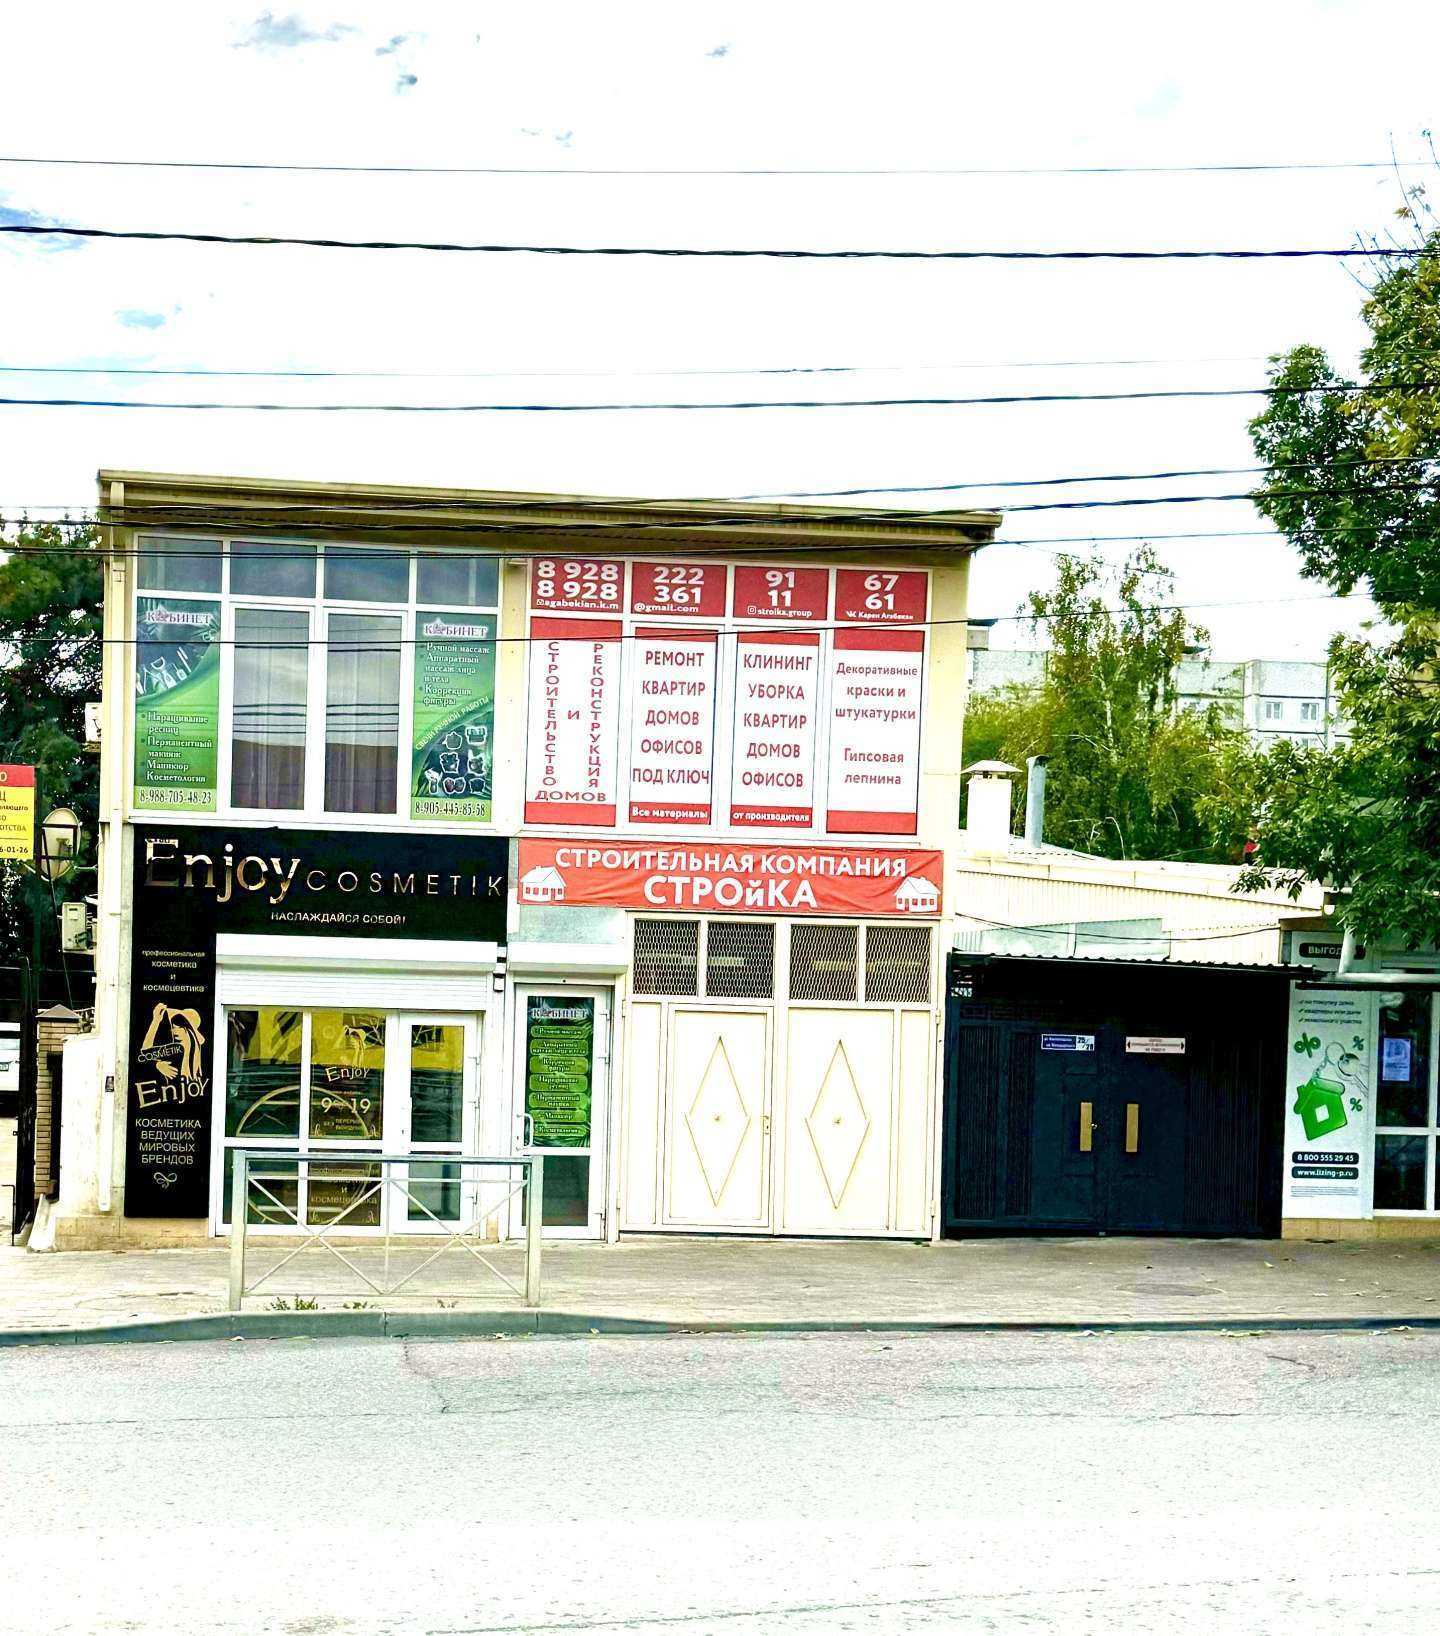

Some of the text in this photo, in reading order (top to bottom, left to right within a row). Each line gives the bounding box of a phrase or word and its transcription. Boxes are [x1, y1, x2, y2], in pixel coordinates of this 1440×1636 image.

[537, 560, 899, 591] 8 928 222 91 67
[537, 580, 895, 610] 8 928 361 11 61
[634, 602, 699, 613] @gmail.com
[645, 650, 704, 667] РЕМОНТ
[743, 654, 812, 671] КЛИНИНГ
[836, 662, 918, 677] Декоративные
[642, 681, 706, 696] КВАРТИР
[748, 684, 805, 700] УБОРКА
[847, 686, 906, 699] краски и
[543, 641, 560, 786] СТРОИТЕЛЬСТВО
[567, 710, 580, 720] И
[588, 643, 604, 788] РЕКОНСТРУКЦИЯ
[645, 710, 699, 727] ДОМОВ
[743, 713, 807, 729] КВАРТИР
[835, 708, 916, 722] штукатурки
[641, 739, 703, 755] ОФИСОВ
[746, 743, 801, 759] ДОМОВ
[844, 748, 904, 763] Гипсовая
[632, 768, 710, 785] ПОД КЛЮЧ
[742, 771, 804, 788] ОФИСОВ
[844, 773, 902, 785] лепнина
[534, 790, 607, 802] ДОМОВ
[632, 806, 708, 819] Все материалы
[732, 812, 745, 820] от
[554, 848, 907, 878] СТРОИТЕЛЬНАЯ КОМПАНИЯ
[144, 838, 503, 904] Enjoy COSMETIK
[271, 912, 360, 923] НАСЛАЖДАЙСЯ
[1308, 946, 1343, 956] ВЫГОД
[151, 961, 197, 969] косметика
[137, 1044, 184, 1063] COSMETIK
[135, 1118, 201, 1129] КОСМЕТИКА
[141, 1131, 195, 1142] ВЕДУЩИХ
[139, 1142, 195, 1153] МИРОВЫХ
[141, 1155, 194, 1165] БРЕНДОВ
[1297, 1169, 1353, 1177] www.lizing-p.ru
